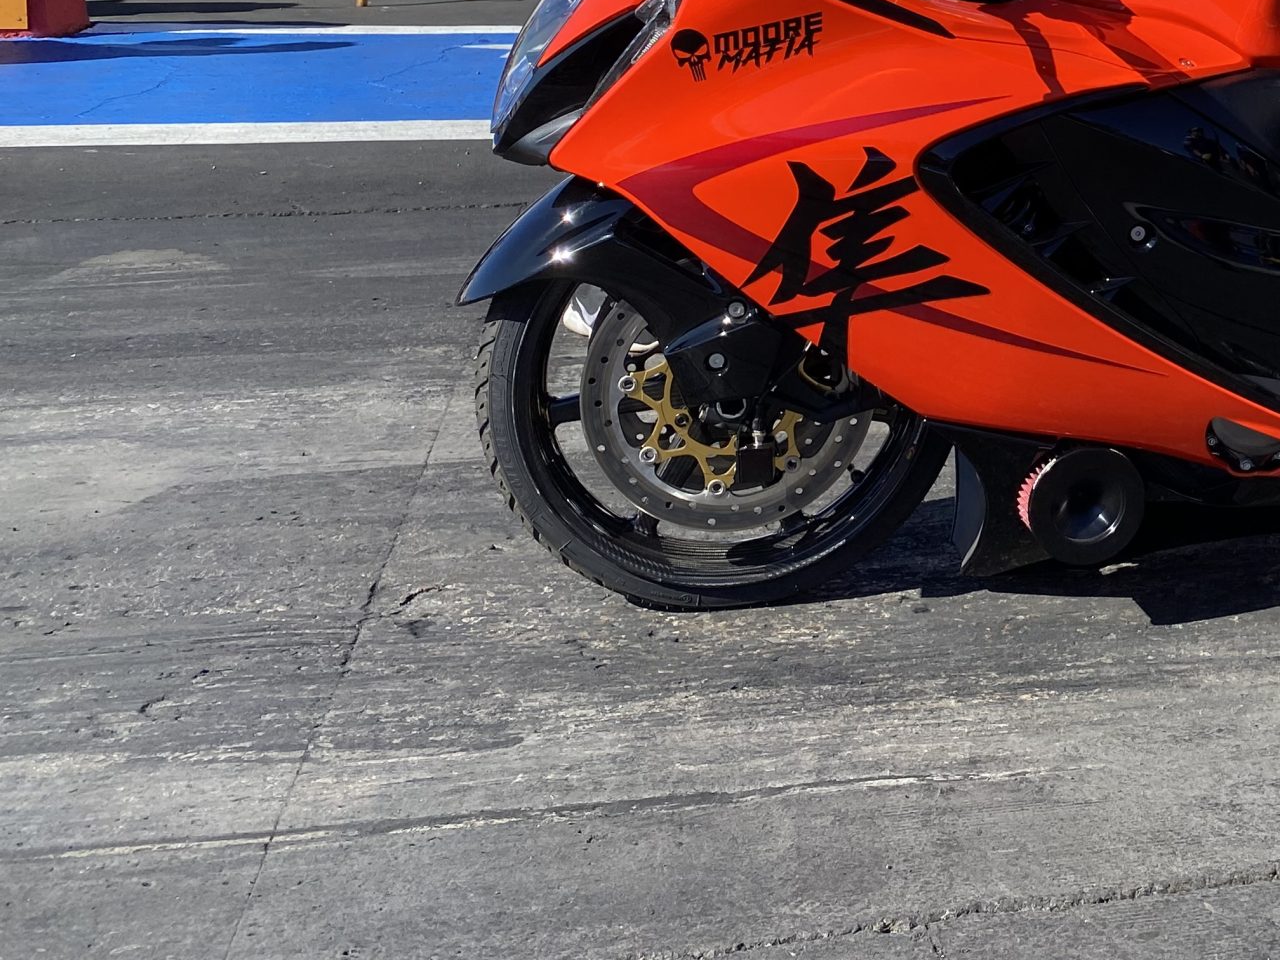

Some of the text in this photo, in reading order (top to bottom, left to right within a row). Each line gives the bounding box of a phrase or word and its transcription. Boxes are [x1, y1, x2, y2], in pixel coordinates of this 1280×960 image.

[712, 12, 823, 54] MOORE
[717, 33, 822, 74] MAFIA
[739, 146, 991, 375] 隼
